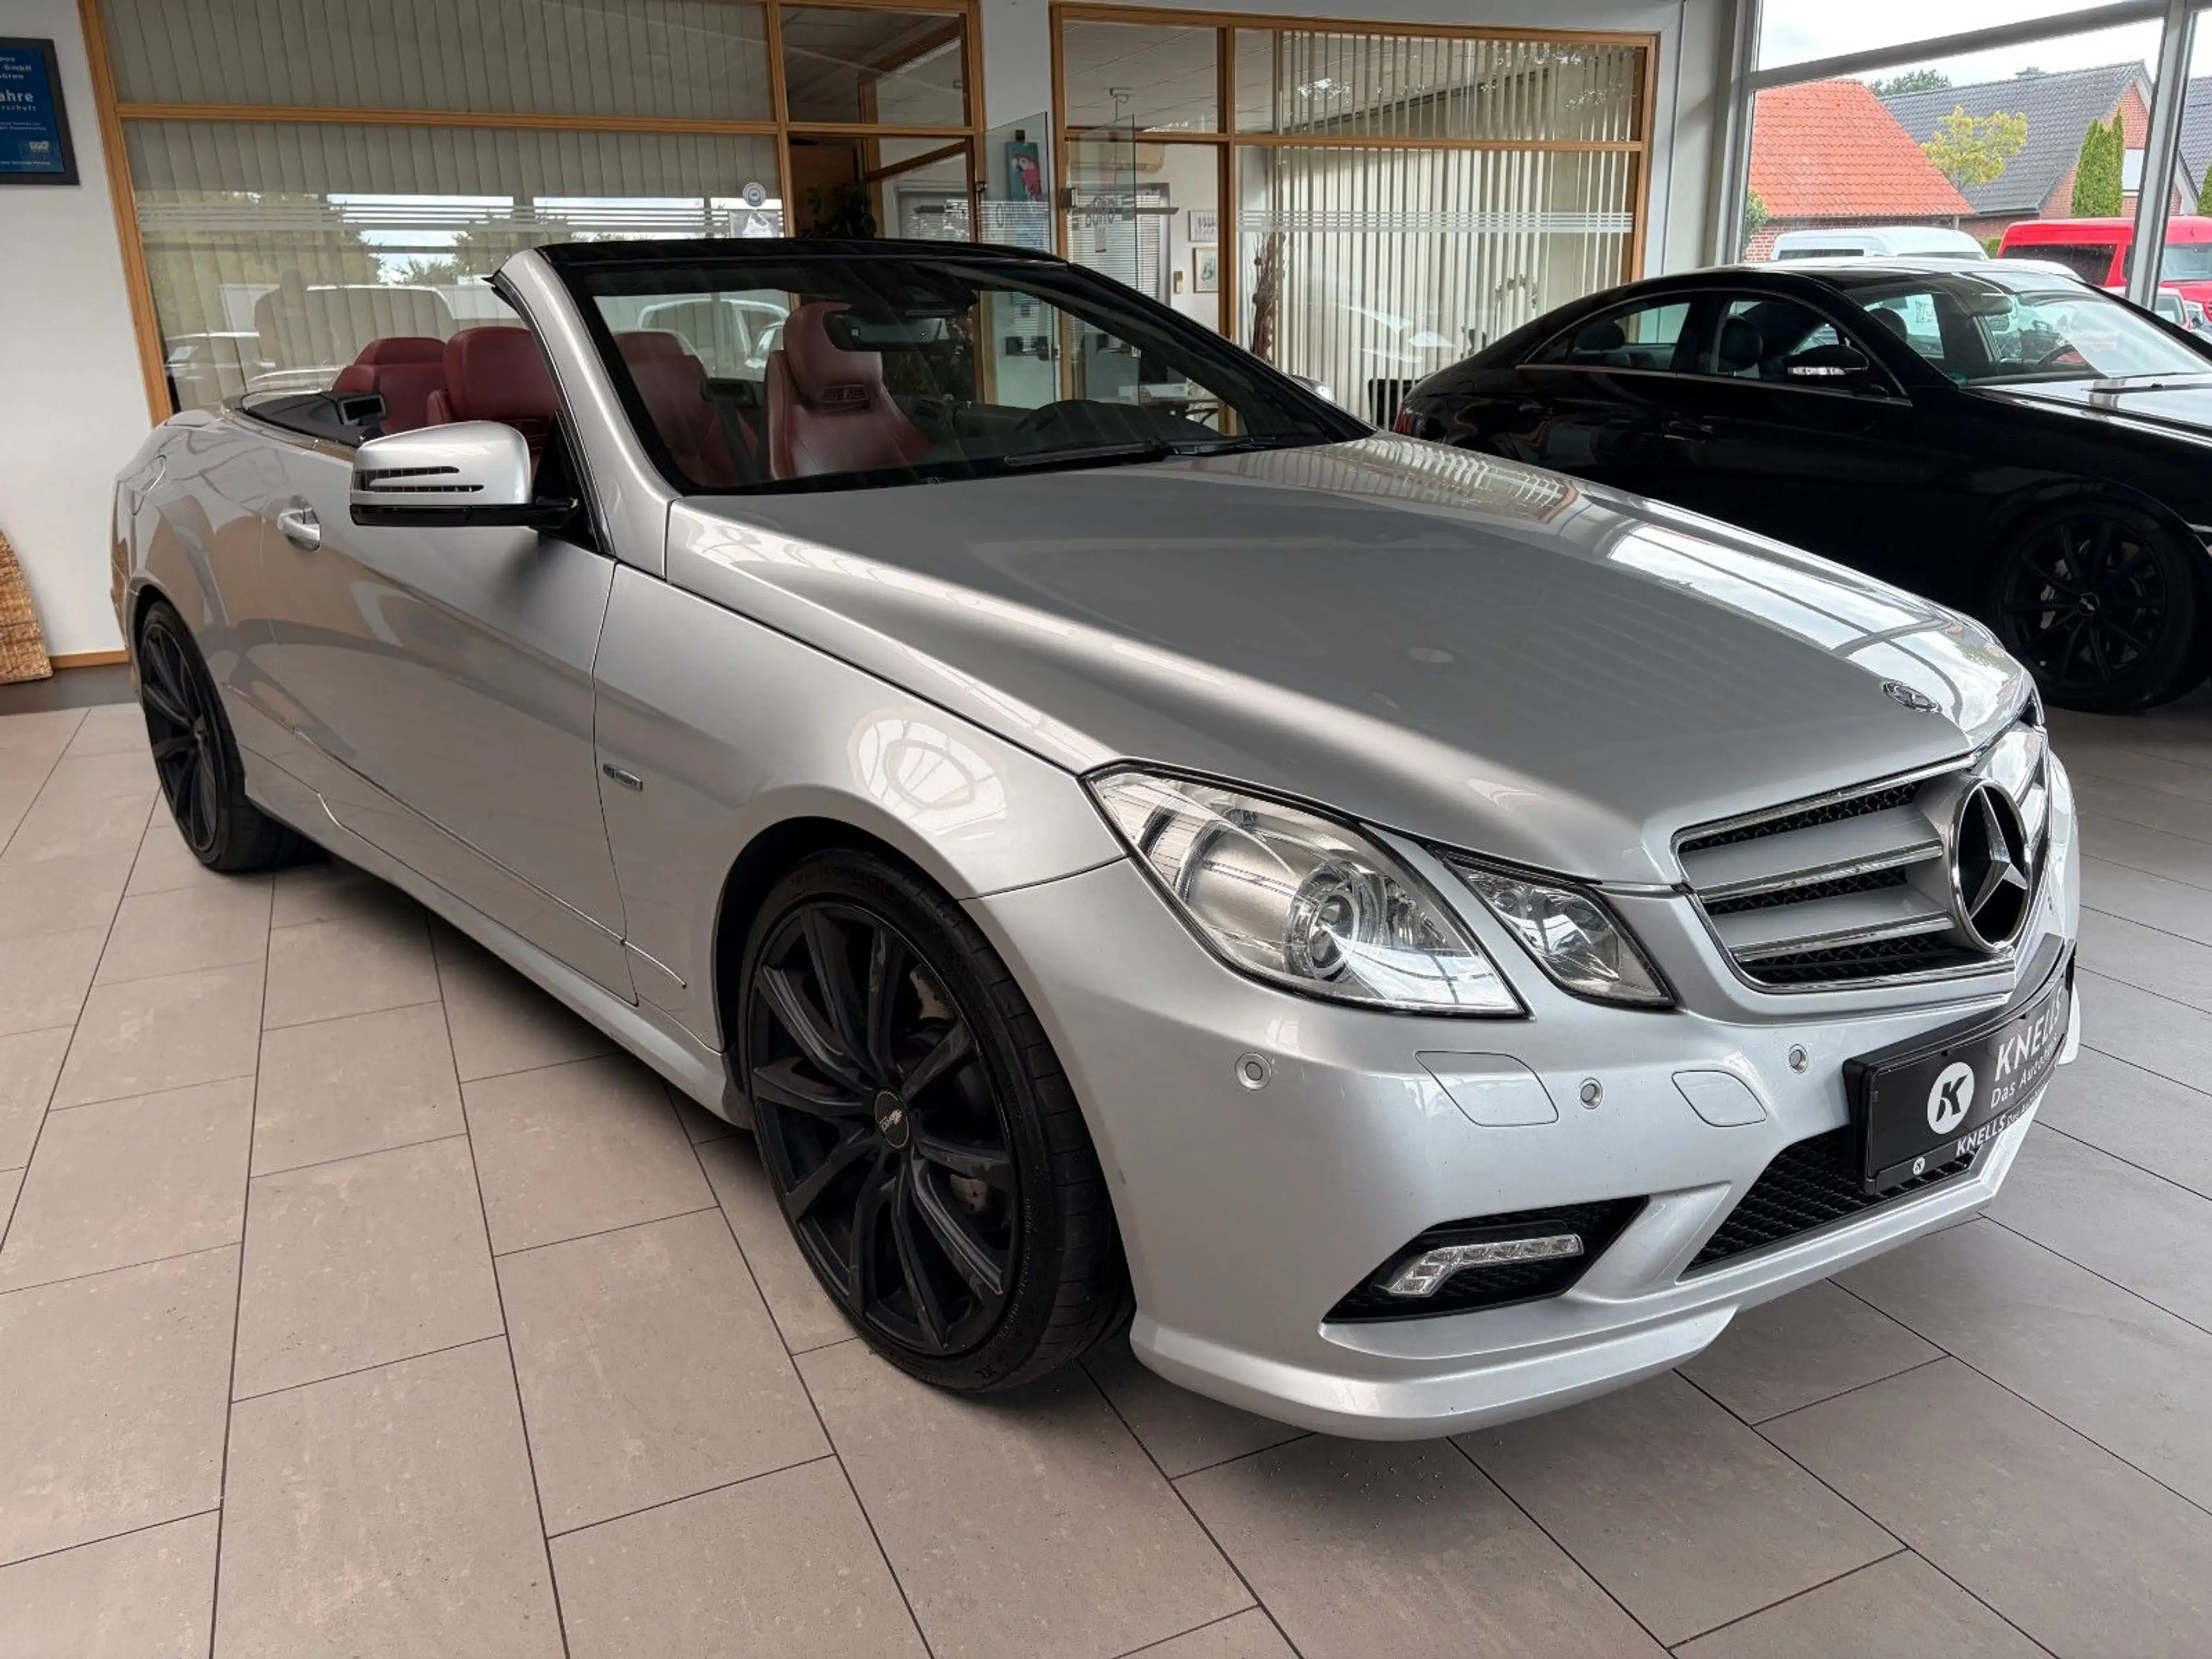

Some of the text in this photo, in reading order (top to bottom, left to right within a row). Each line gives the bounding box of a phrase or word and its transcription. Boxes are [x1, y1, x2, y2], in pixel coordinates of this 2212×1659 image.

[1995, 986, 2062, 1082] KNELLS
[1990, 1082, 2016, 1109] Das
[1956, 1112, 2006, 1157] KNELLS
